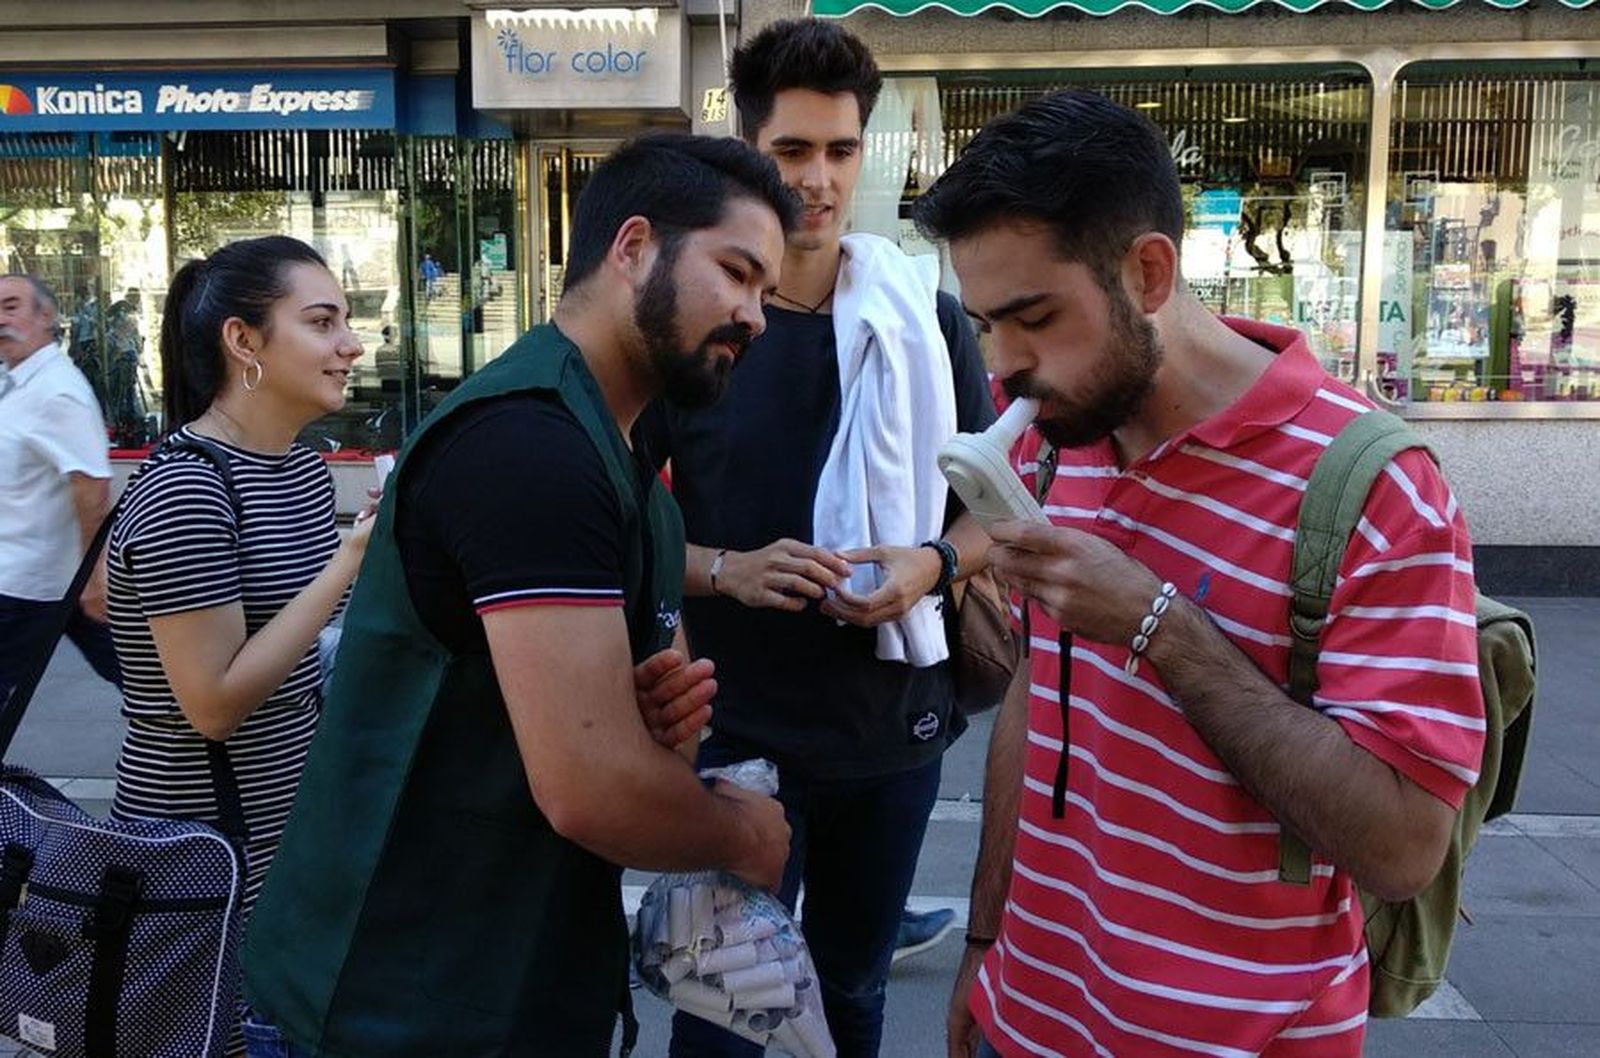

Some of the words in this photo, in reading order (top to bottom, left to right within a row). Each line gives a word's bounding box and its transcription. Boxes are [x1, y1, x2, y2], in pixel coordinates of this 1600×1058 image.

[505, 39, 557, 74] flor
[571, 42, 647, 73] color
[36, 84, 143, 114] Konica
[155, 84, 242, 114] Photo
[249, 83, 362, 116] Express
[707, 90, 726, 108] 14
